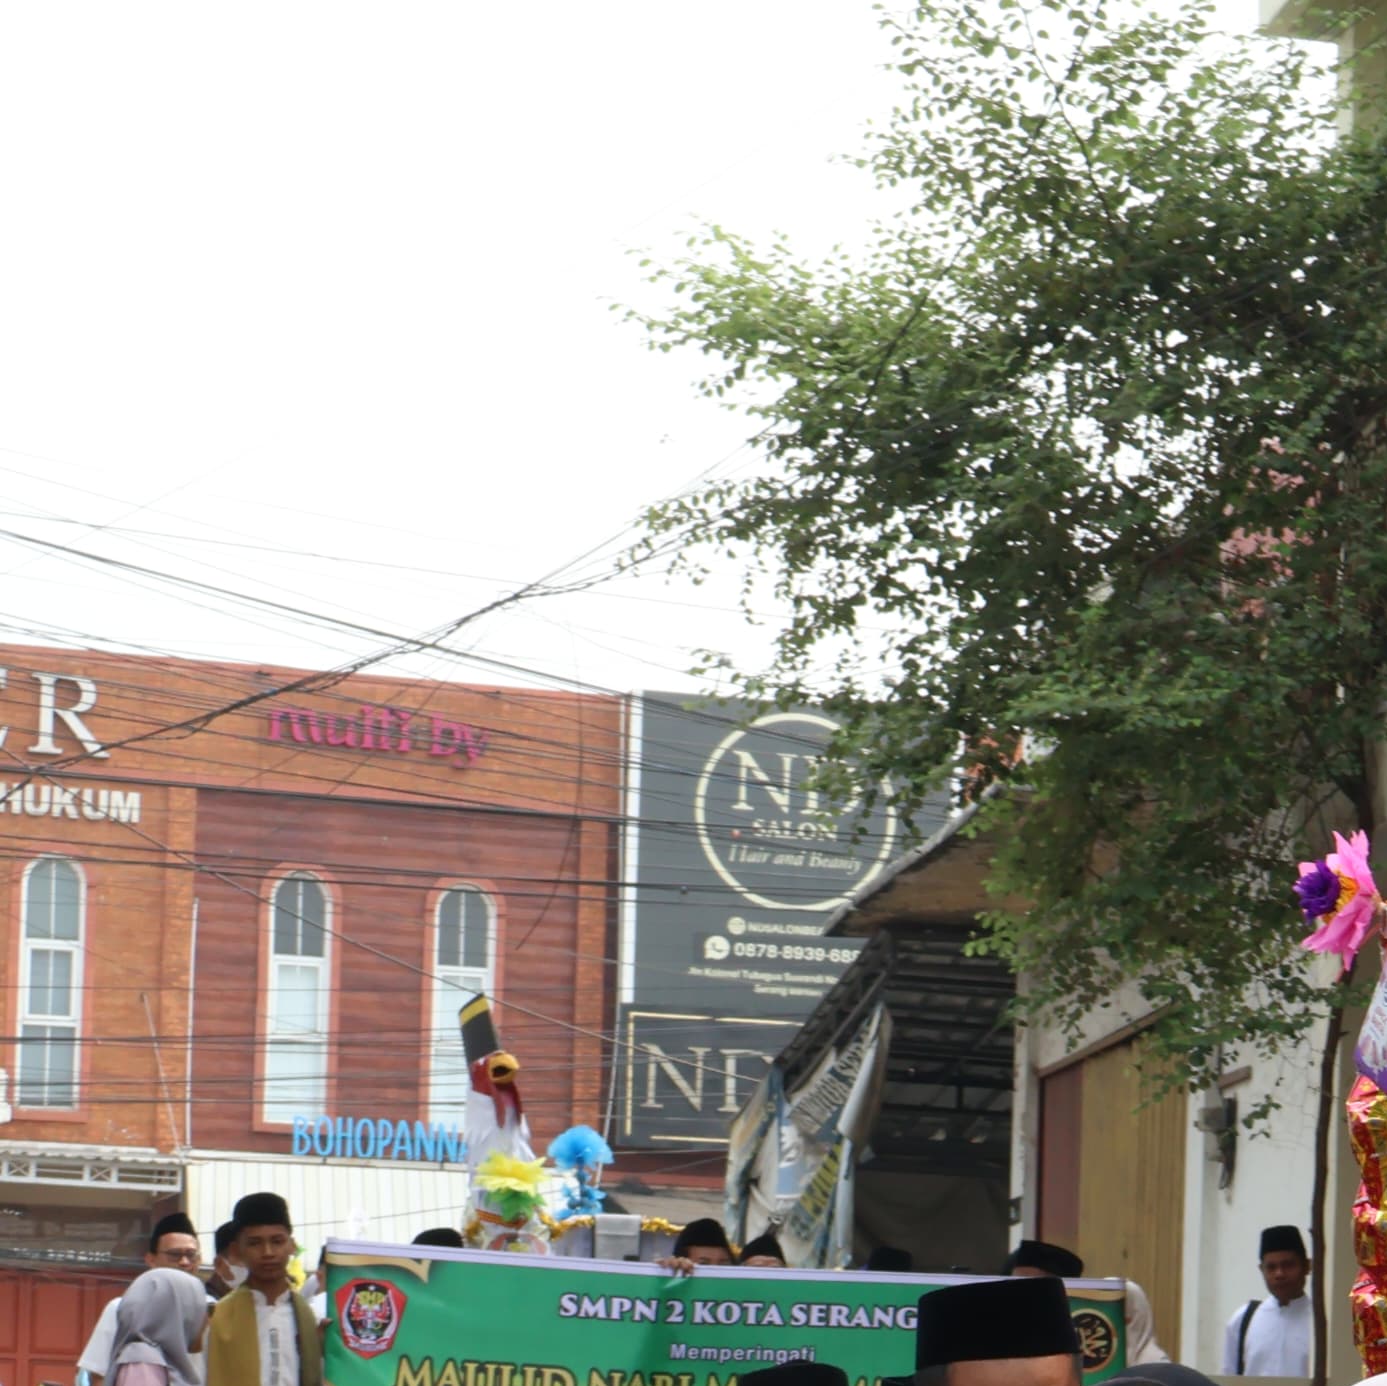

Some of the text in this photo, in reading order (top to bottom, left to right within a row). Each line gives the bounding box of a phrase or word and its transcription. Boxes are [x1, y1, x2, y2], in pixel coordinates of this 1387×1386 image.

[0, 667, 111, 758] R
[0, 782, 141, 824] HUKUM
[752, 819, 839, 841] SALON
[292, 1114, 468, 1162] BOHOPANN
[559, 1293, 918, 1330] SMPN 2 KOTA SERANG
[669, 1343, 816, 1364] Memperingati
